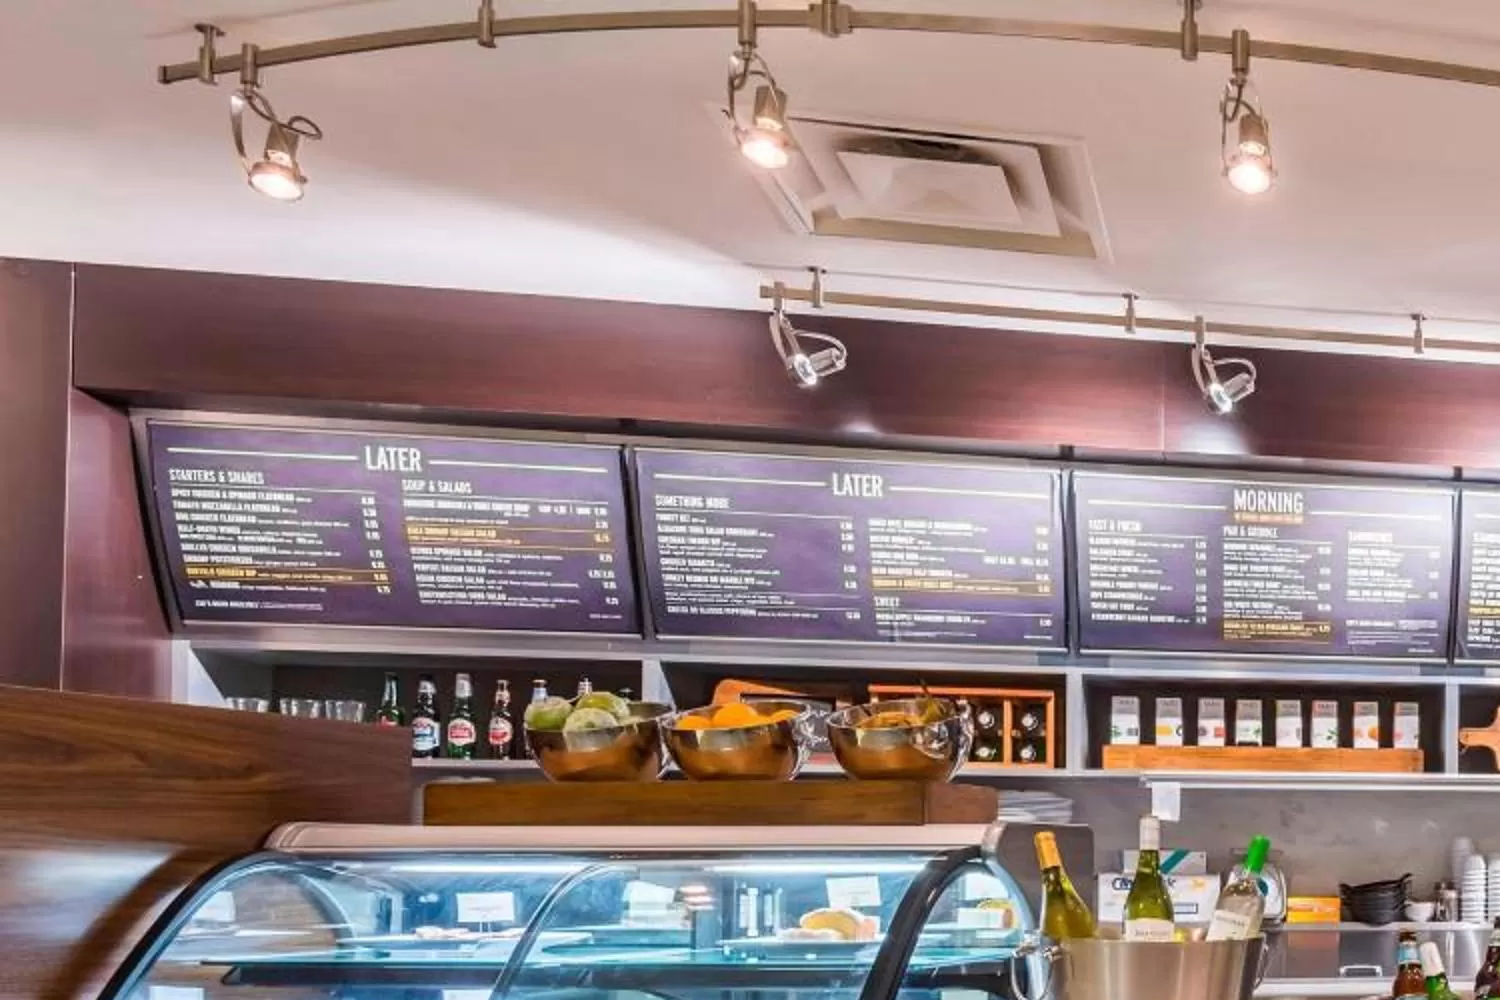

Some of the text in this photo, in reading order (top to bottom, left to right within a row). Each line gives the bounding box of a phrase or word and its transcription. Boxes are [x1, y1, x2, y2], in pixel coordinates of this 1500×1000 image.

[364, 445, 422, 472] LATER
[832, 472, 883, 497] LATER
[1233, 489, 1303, 513] MORNING
